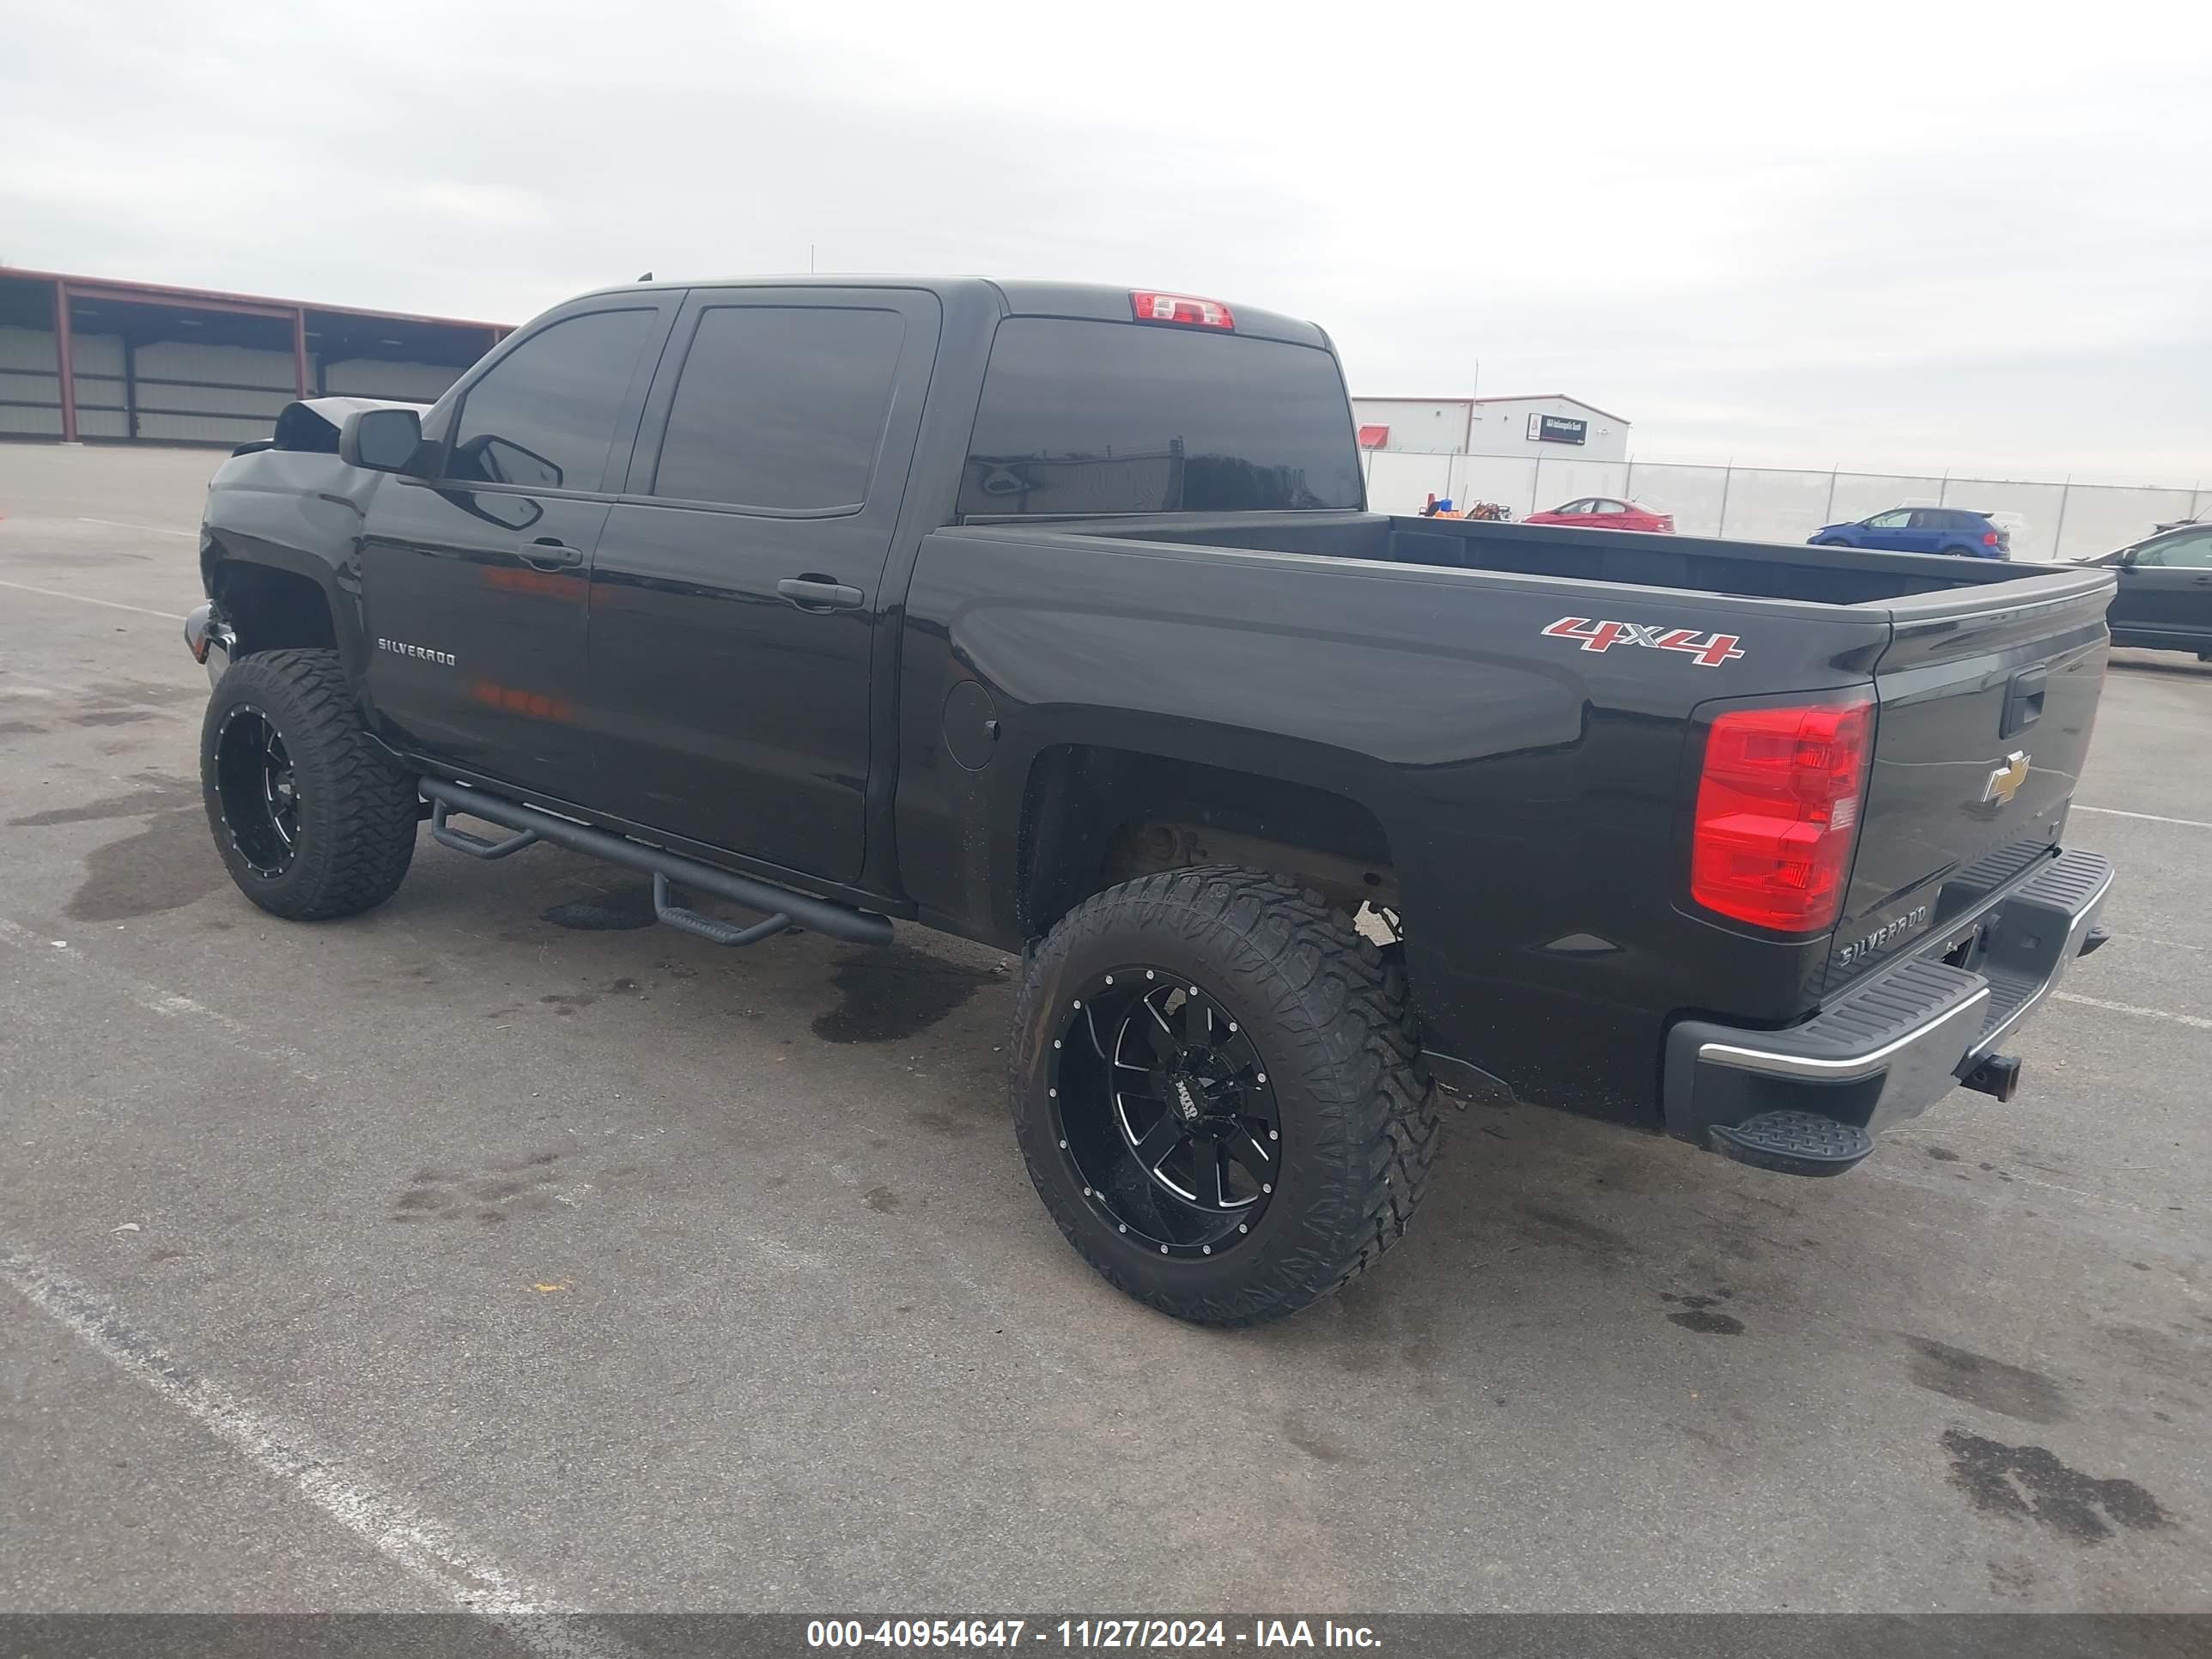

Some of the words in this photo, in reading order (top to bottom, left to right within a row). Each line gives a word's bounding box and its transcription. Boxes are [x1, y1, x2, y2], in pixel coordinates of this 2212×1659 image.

[378, 638, 456, 666] SILVERADO
[1839, 906, 1926, 967] SILVERADO
[1175, 1078, 1198, 1118] MOTO
